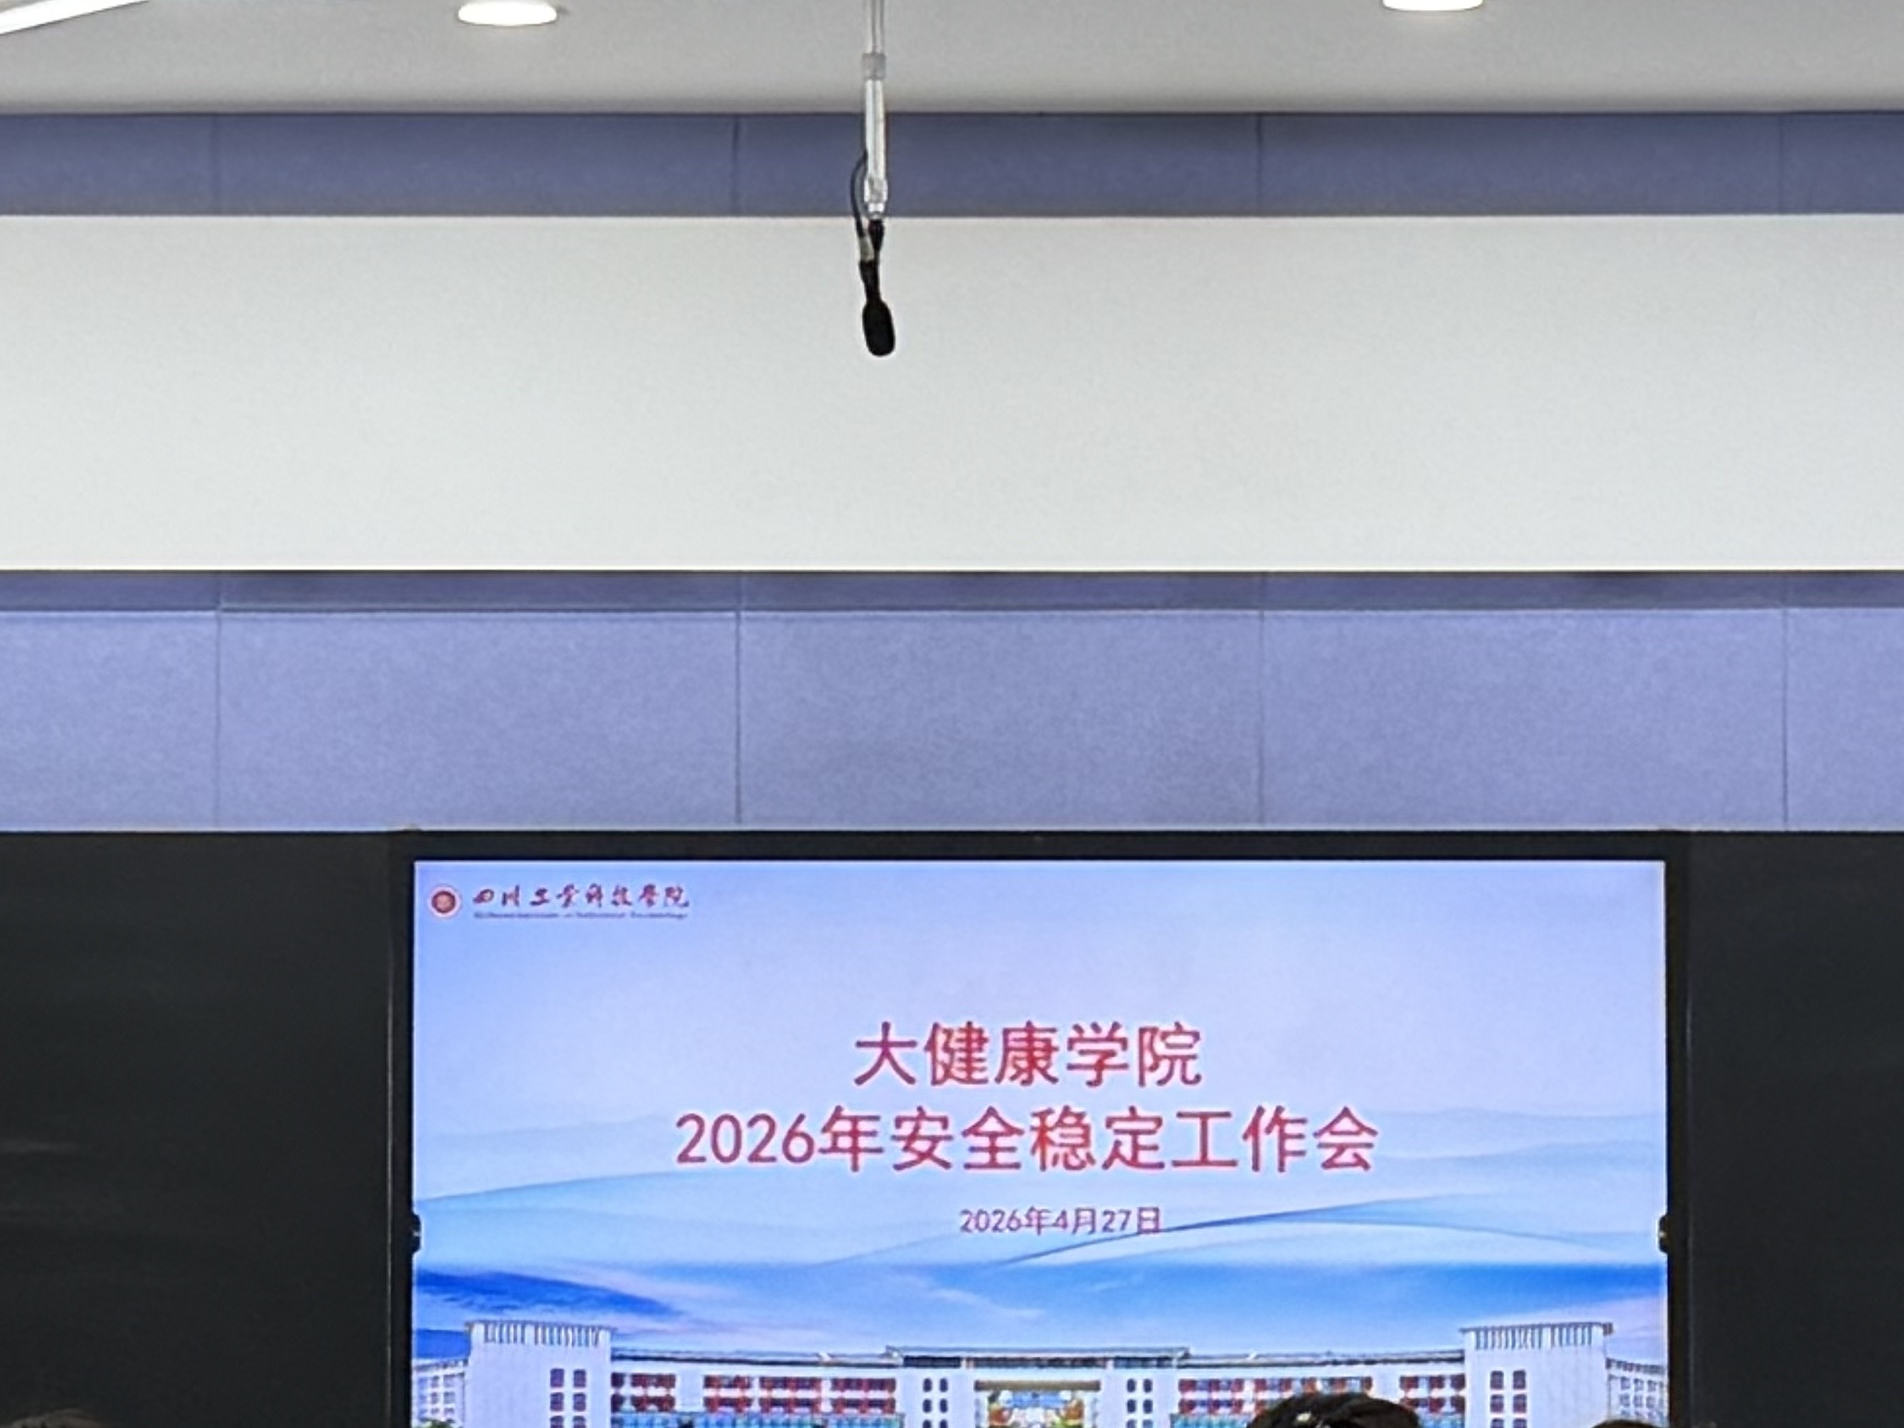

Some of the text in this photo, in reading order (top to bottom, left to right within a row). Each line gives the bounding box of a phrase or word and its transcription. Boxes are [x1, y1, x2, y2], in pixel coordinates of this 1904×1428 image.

[853, 1020, 1203, 1088] 大健康学院
[675, 1104, 1380, 1172] 2026年安全稳定工作会
[959, 1205, 1163, 1235] 2026年4月27日
